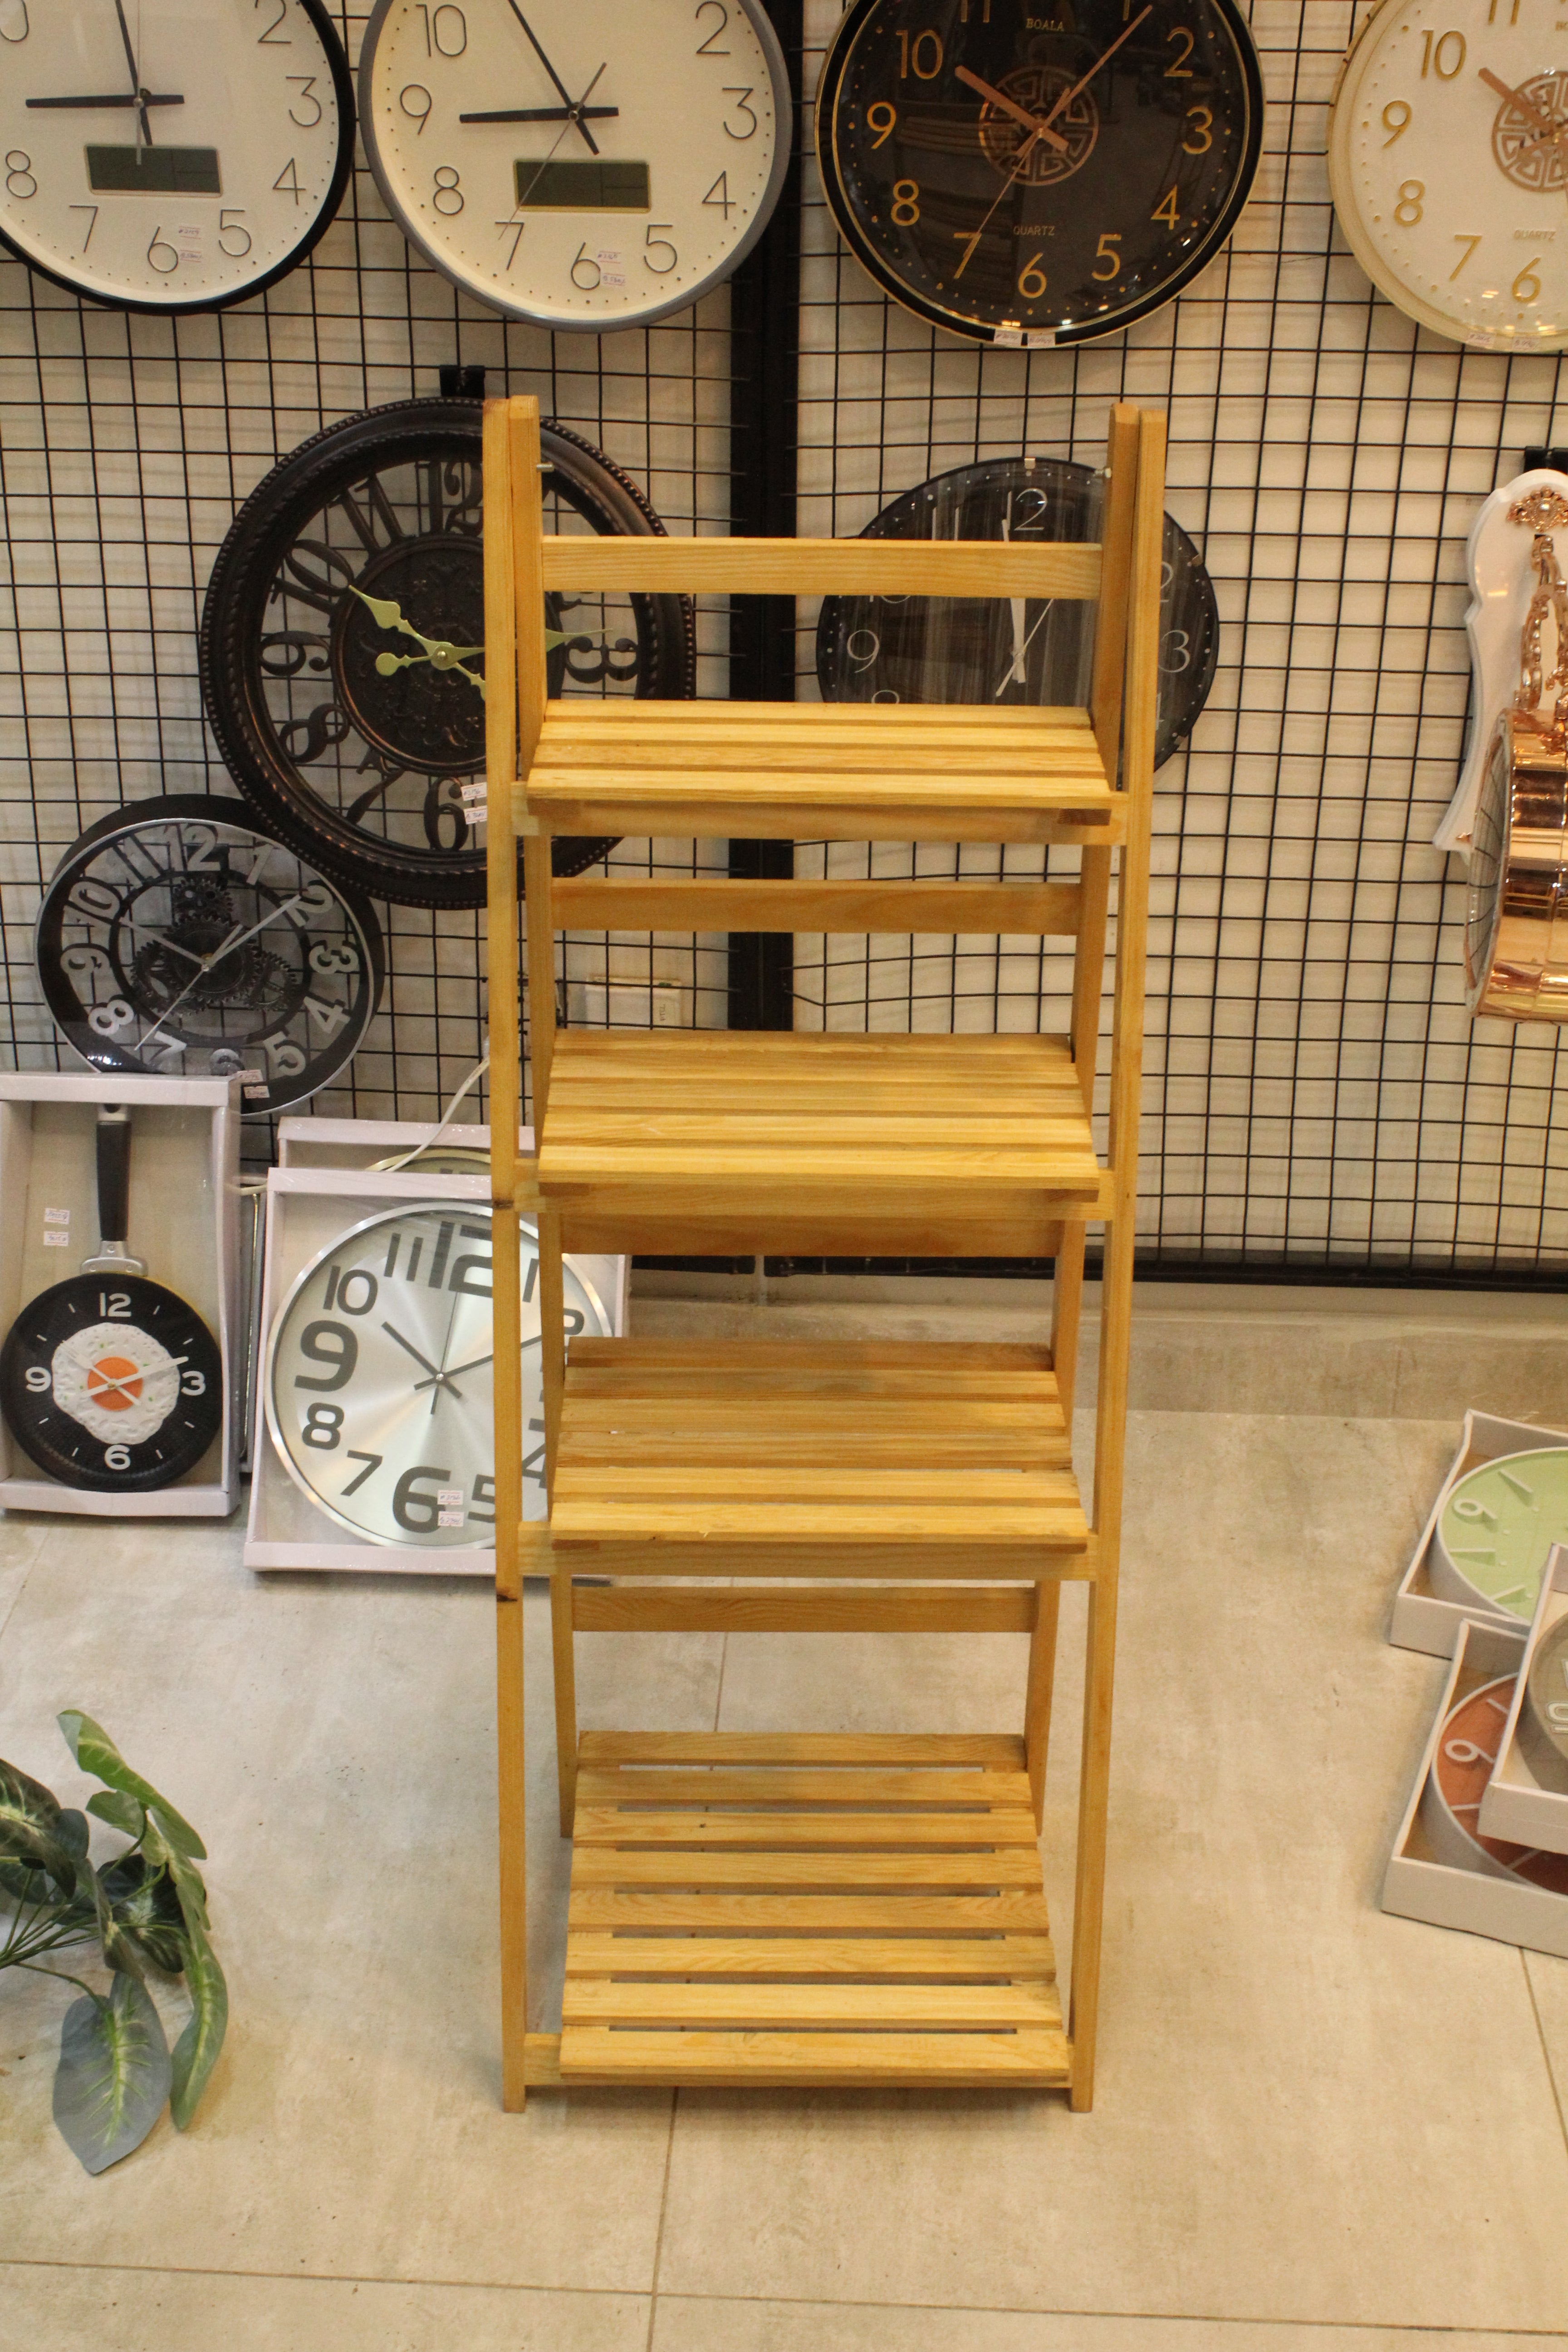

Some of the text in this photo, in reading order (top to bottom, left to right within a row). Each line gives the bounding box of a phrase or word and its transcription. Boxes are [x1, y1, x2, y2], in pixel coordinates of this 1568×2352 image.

[255, 0, 292, 44] 2
[416, 4, 467, 57] 10
[696, 1, 730, 55] 2
[1025, 18, 1064, 31] BOALA
[896, 29, 944, 80] 10
[1164, 26, 1194, 78] 2
[1421, 29, 1467, 81] 10
[286, 76, 322, 127] 3
[400, 84, 432, 135] 9
[722, 87, 757, 139] 3
[867, 101, 897, 149] 9
[1382, 100, 1412, 149] 9
[1181, 106, 1213, 155] 3
[5, 150, 37, 198] 8
[273, 157, 306, 205] 4
[432, 166, 464, 216] 8
[702, 171, 736, 220] 4
[891, 179, 921, 226] 8
[1150, 185, 1180, 230] 4
[1394, 179, 1426, 227] 8
[69, 206, 98, 253] 7
[147, 226, 178, 273] 6
[219, 210, 252, 256] 5
[495, 221, 524, 271] 7
[643, 224, 677, 273] 5
[1013, 225, 1056, 237] QUARTZ
[1514, 228, 1556, 241] QUARTZ
[570, 242, 601, 290] 6
[953, 231, 982, 279] 7
[1018, 252, 1048, 299] 6
[1091, 233, 1122, 281] 5
[1450, 234, 1483, 281] 7
[1511, 257, 1541, 304] 6
[327, 472, 412, 556] 11
[416, 459, 483, 536] 12
[1006, 488, 1048, 531] 12
[270, 539, 355, 615] 10
[565, 637, 638, 684] 3
[847, 629, 879, 673] 9
[1158, 629, 1190, 673] 3
[279, 703, 350, 763] 8
[345, 749, 406, 825] 7
[424, 777, 470, 851] 6
[107, 834, 162, 889] 11
[165, 823, 220, 871] 12
[246, 843, 273, 885] 1
[63, 880, 121, 934] 10
[280, 884, 333, 927] 2
[60, 947, 109, 976] 9
[309, 944, 360, 975] 3
[88, 999, 134, 1036] 8
[304, 996, 350, 1034] 4
[264, 1031, 306, 1076] 5
[383, 1233, 424, 1282] 11
[428, 1221, 493, 1298] 12
[99, 1292, 132, 1318] 12
[323, 1265, 379, 1316] 10
[25, 1366, 52, 1392] 9
[294, 1319, 358, 1392] 9
[181, 1370, 206, 1396] 3
[302, 1401, 345, 1450] 8
[104, 1444, 131, 1471] 6
[340, 1450, 383, 1497] 7
[392, 1465, 452, 1534] 6
[468, 1474, 495, 1524] 5
